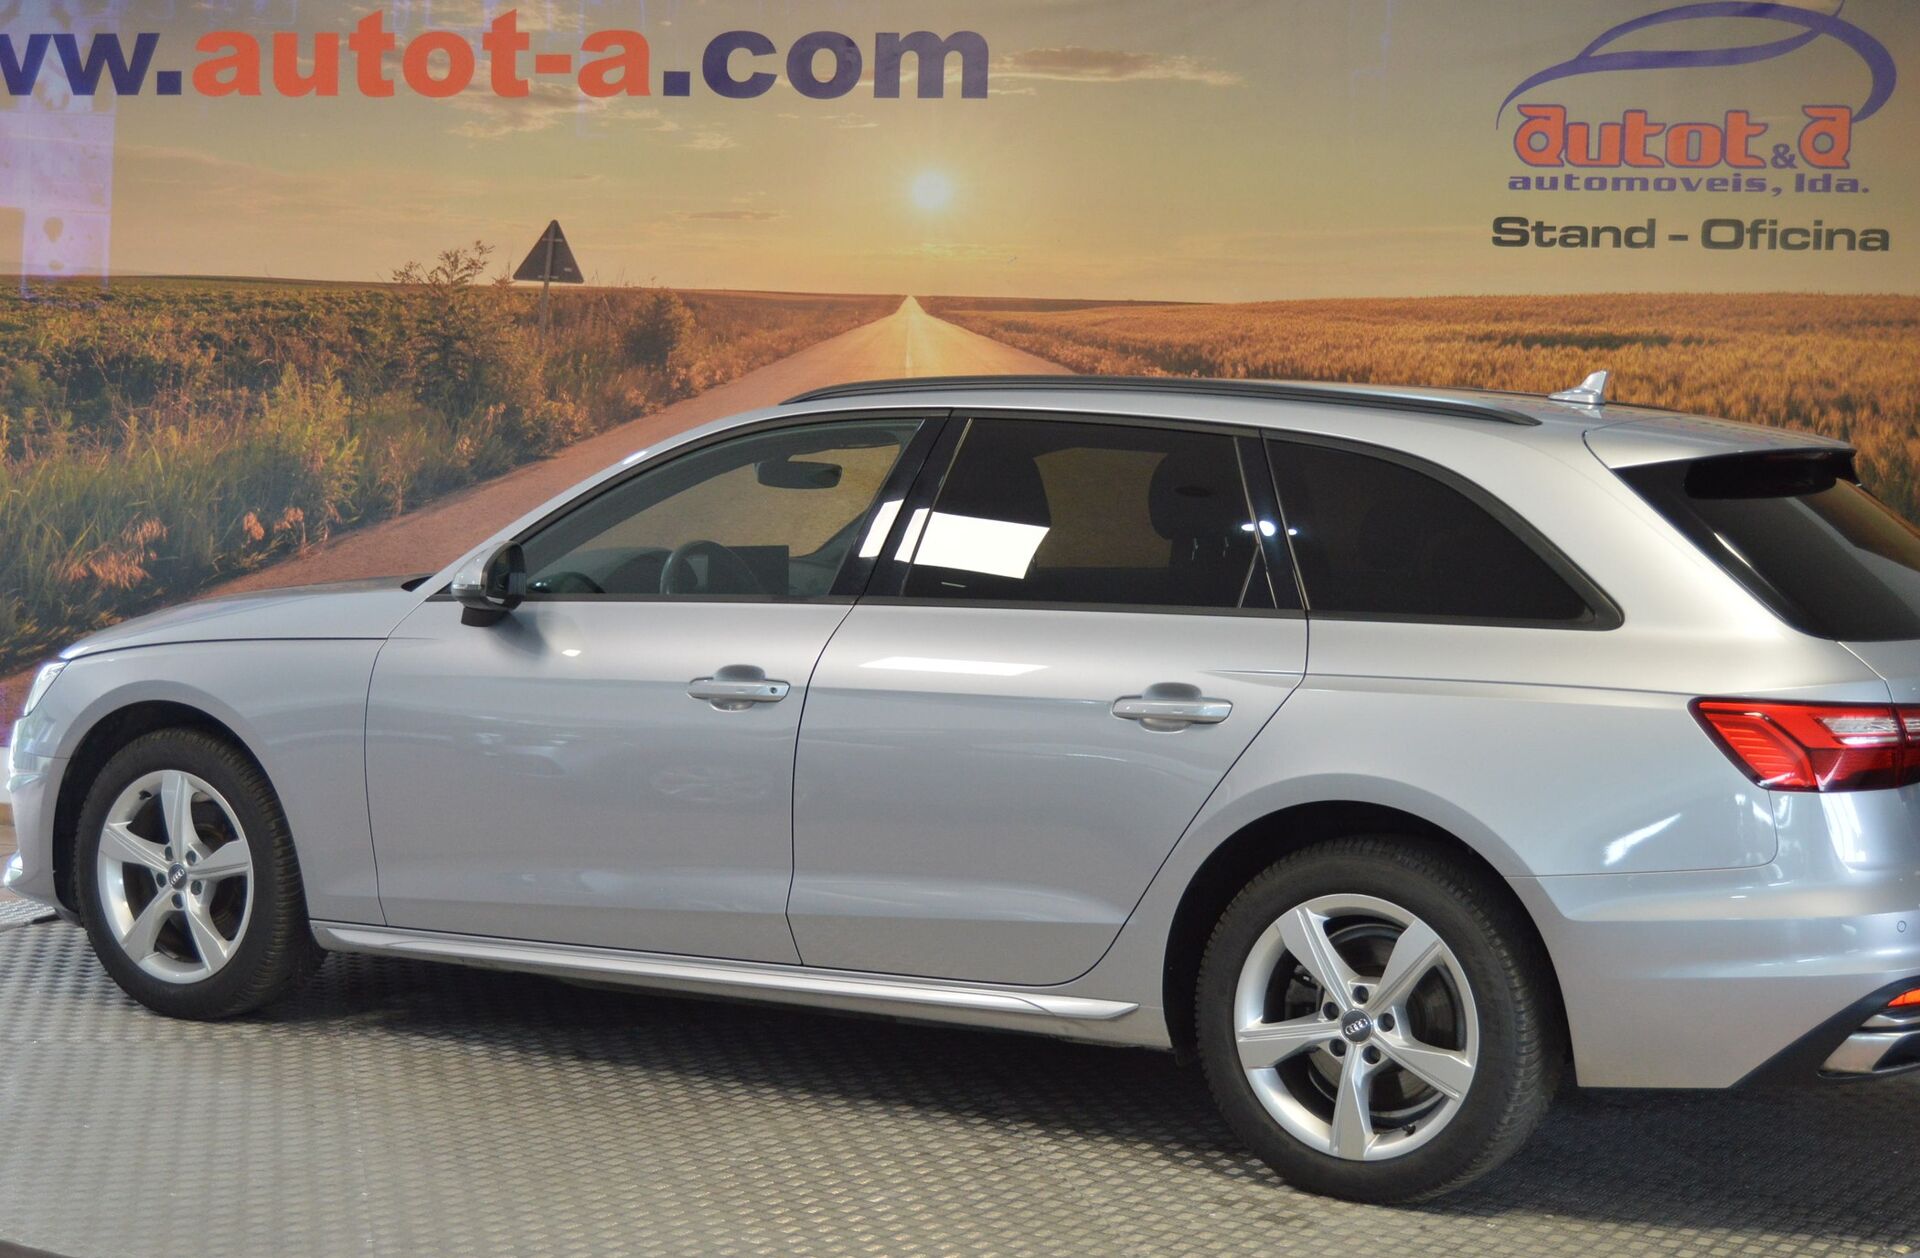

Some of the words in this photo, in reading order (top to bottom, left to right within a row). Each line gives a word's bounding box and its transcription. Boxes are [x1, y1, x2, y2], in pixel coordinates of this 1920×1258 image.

[1508, 173, 1782, 196] automoveis,
[1795, 173, 1870, 194] lda.
[1491, 216, 1656, 249] Stand
[1700, 218, 1891, 252] Oficina
